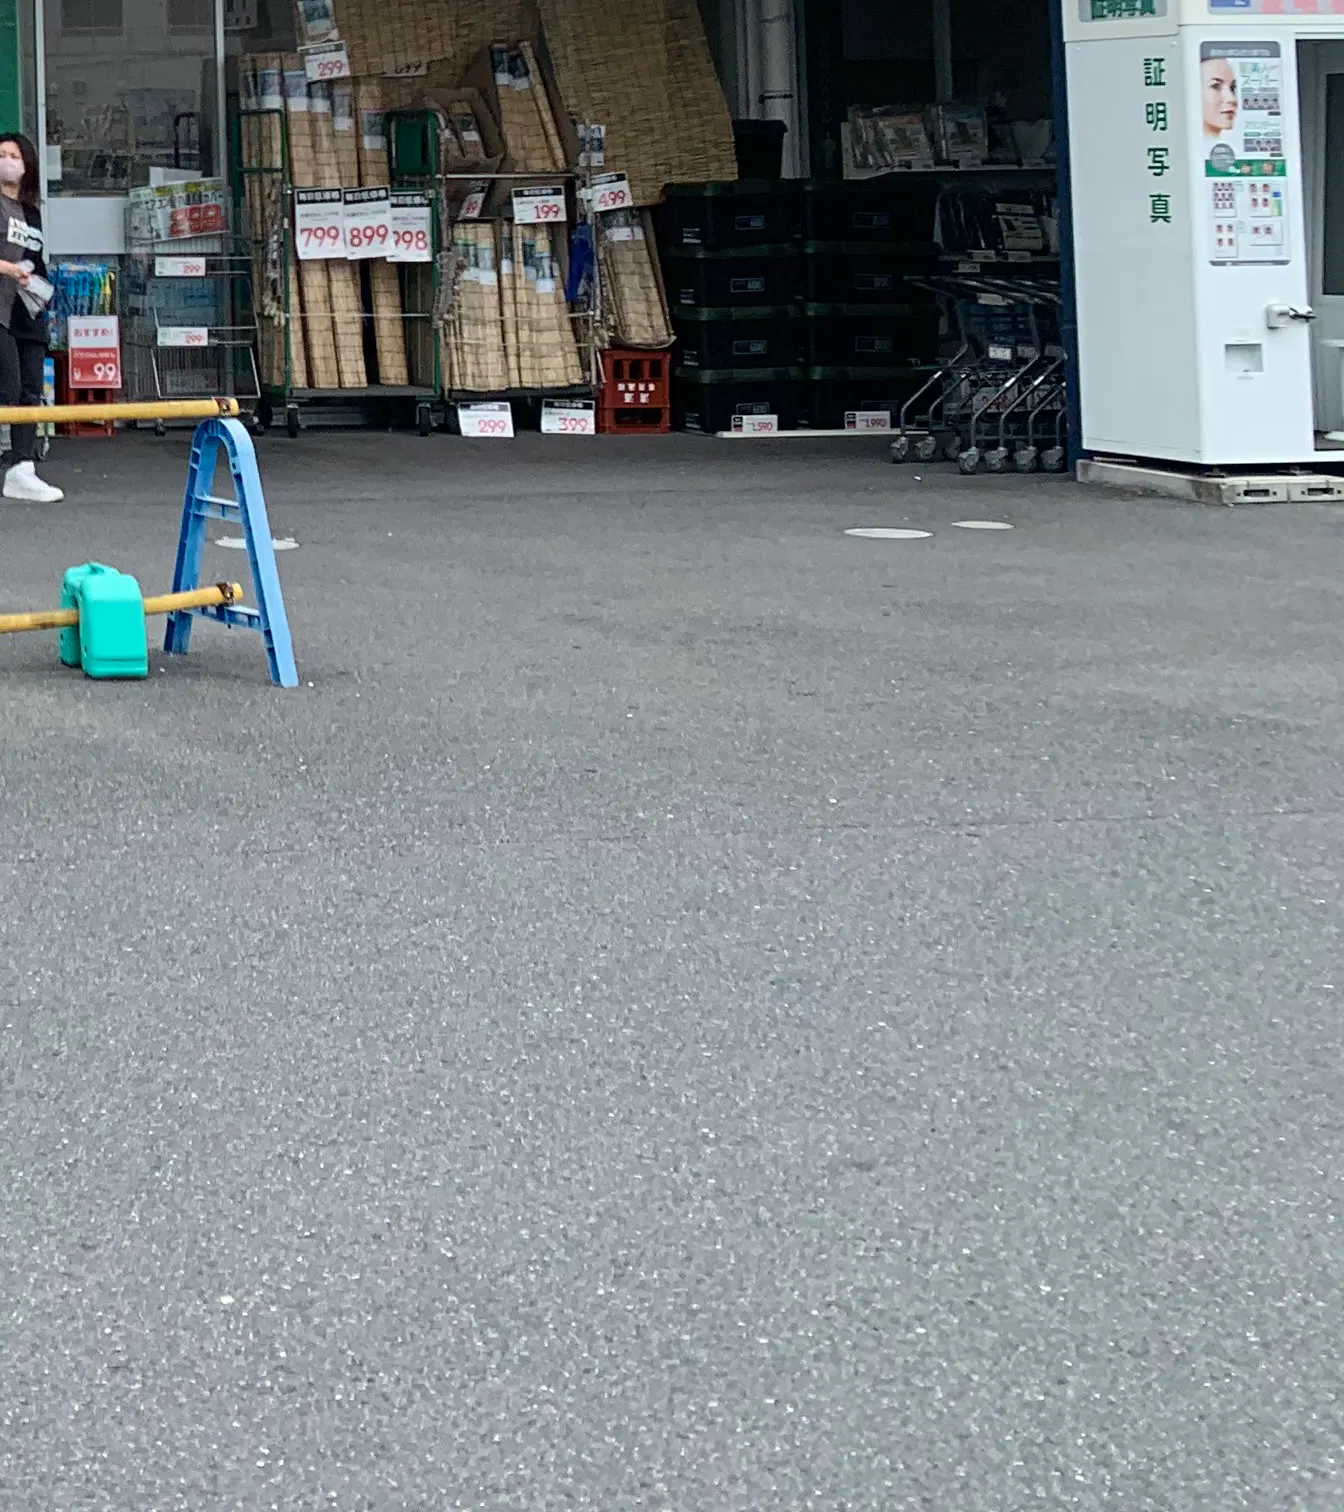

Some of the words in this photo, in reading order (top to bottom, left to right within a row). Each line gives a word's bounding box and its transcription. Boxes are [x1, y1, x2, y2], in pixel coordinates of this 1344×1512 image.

[1142, 55, 1173, 224] 証明写真
[598, 190, 627, 207] 499
[534, 203, 561, 220] 199
[299, 225, 341, 248] 799
[350, 224, 389, 248] 899
[93, 362, 117, 381] 99
[478, 419, 507, 434] 299
[558, 418, 588, 433] 399
